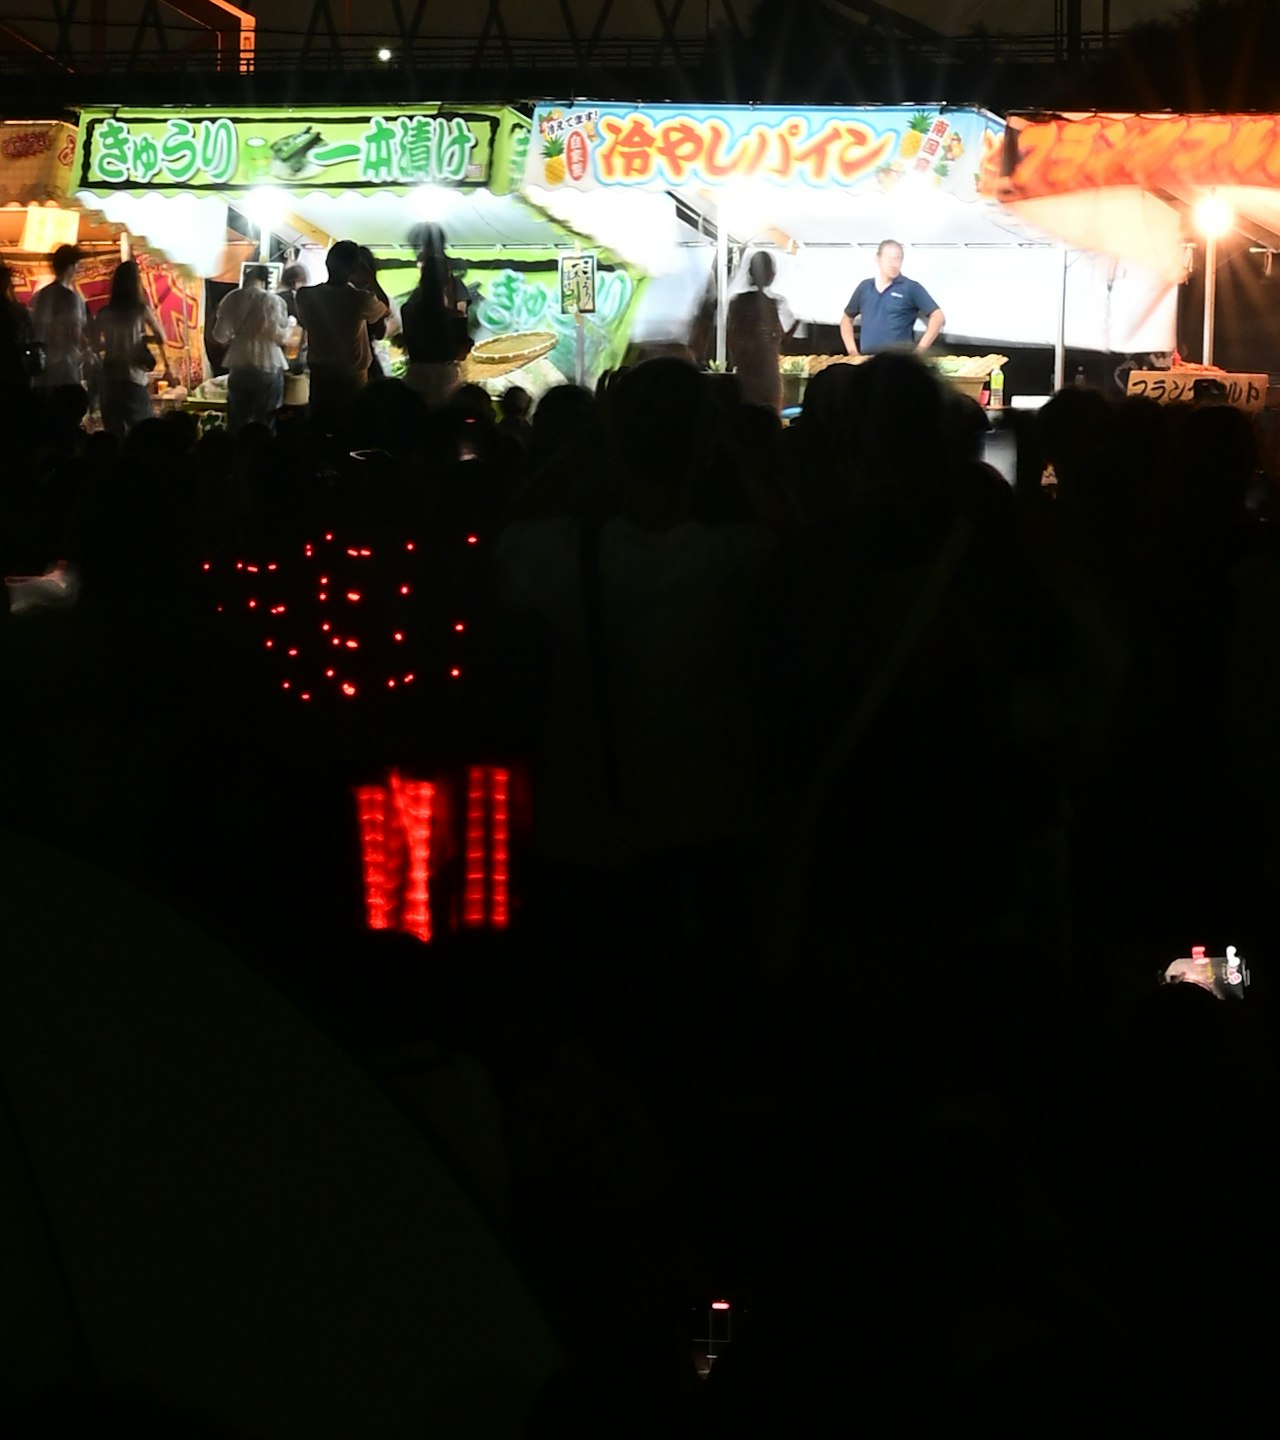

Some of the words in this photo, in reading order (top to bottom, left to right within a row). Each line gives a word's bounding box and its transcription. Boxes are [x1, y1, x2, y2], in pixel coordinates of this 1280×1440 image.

[94, 118, 240, 183] きゅうり
[308, 114, 476, 182] 一本漬け
[599, 117, 890, 181] 冷やしパイン
